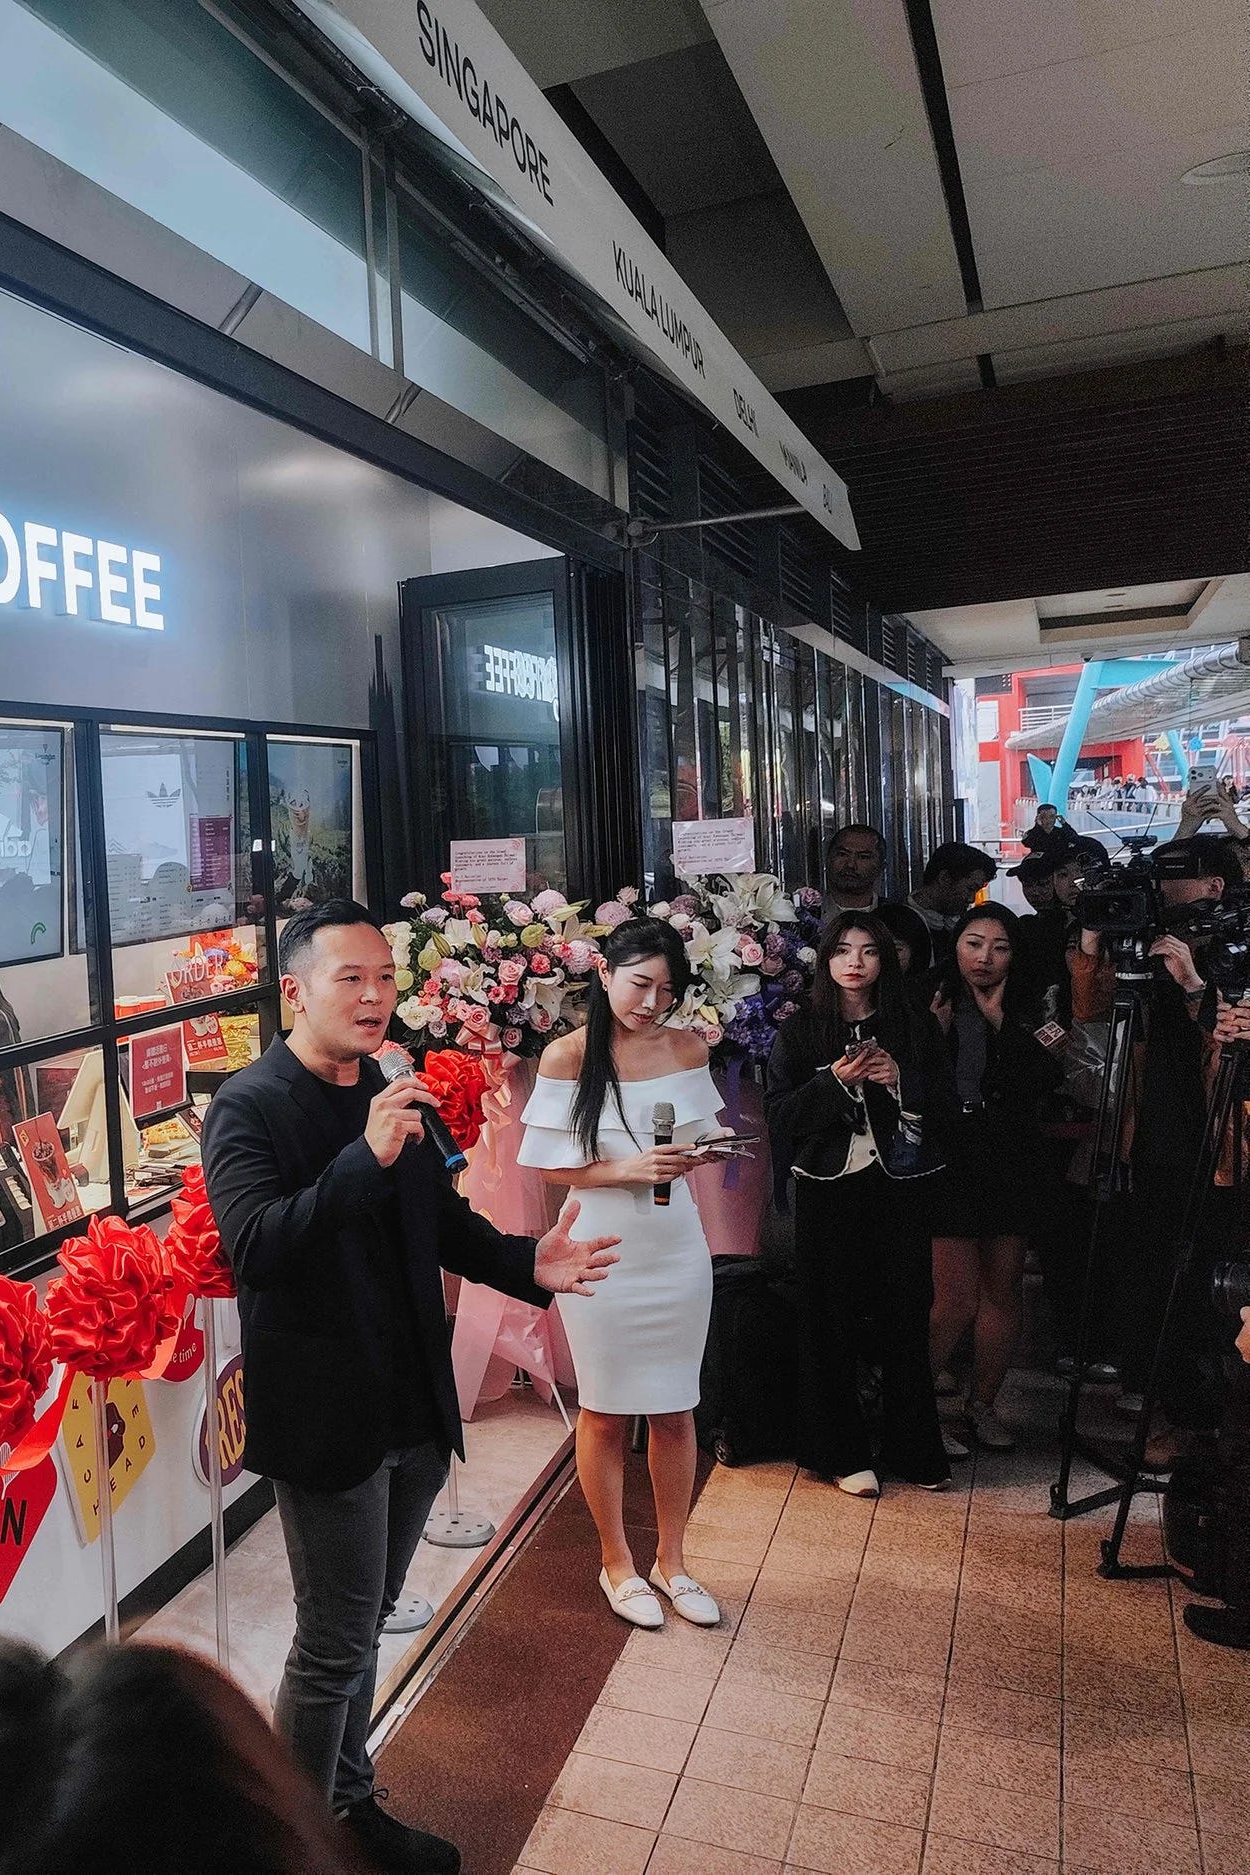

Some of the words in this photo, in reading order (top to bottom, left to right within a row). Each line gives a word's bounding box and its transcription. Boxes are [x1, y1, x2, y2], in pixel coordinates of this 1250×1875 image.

[416, 0, 554, 206] SINGAPORE
[612, 241, 661, 328] KUALA
[659, 295, 706, 380] LUMPUR
[178, 1342, 198, 1364] time
[205, 1368, 246, 1470] RES
